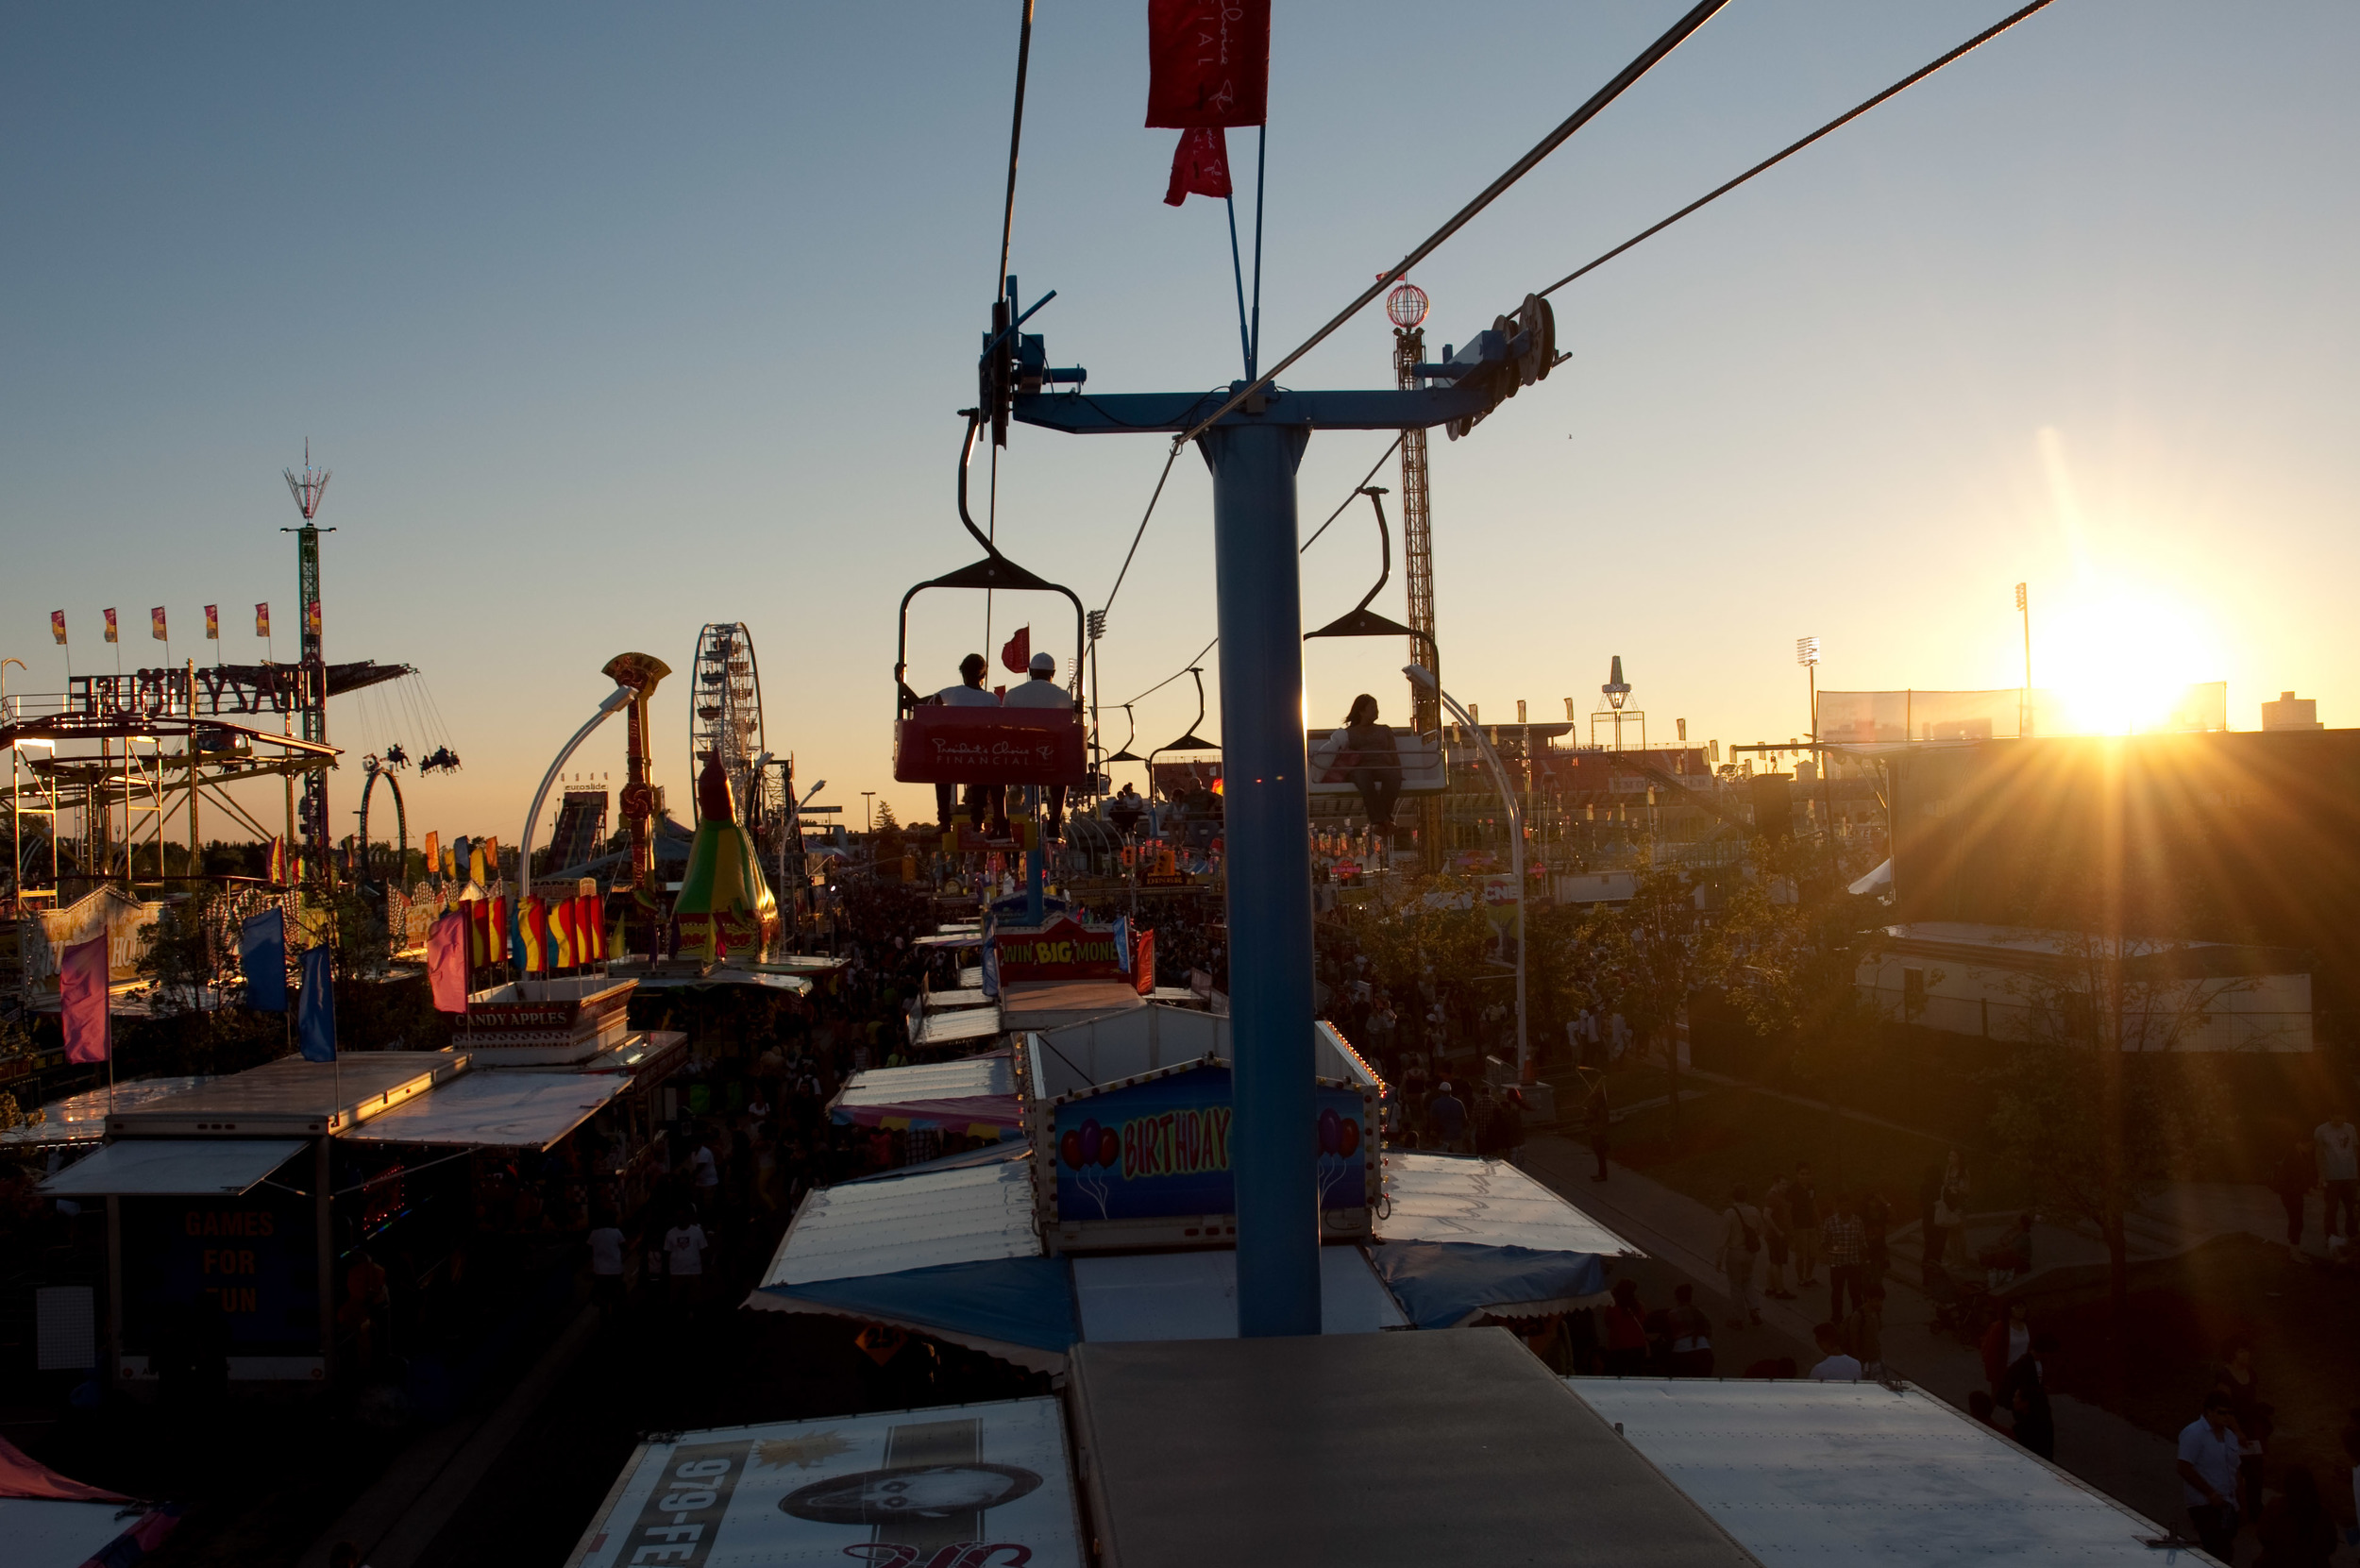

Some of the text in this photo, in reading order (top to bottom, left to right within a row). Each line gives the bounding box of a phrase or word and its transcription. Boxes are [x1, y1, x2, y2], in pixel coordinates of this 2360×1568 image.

[936, 755, 1030, 767] FINANCIAL
[565, 783, 607, 791] euroslide
[1484, 885, 1519, 902] CNE
[1003, 944, 1034, 964] WIN
[1036, 940, 1073, 965] BIG
[455, 1013, 507, 1027] CANDY
[511, 1011, 568, 1026] APPLES
[1124, 1106, 1231, 1177] BIRTHDAY
[184, 1210, 276, 1238] GAMES
[203, 1248, 257, 1275] FOR
